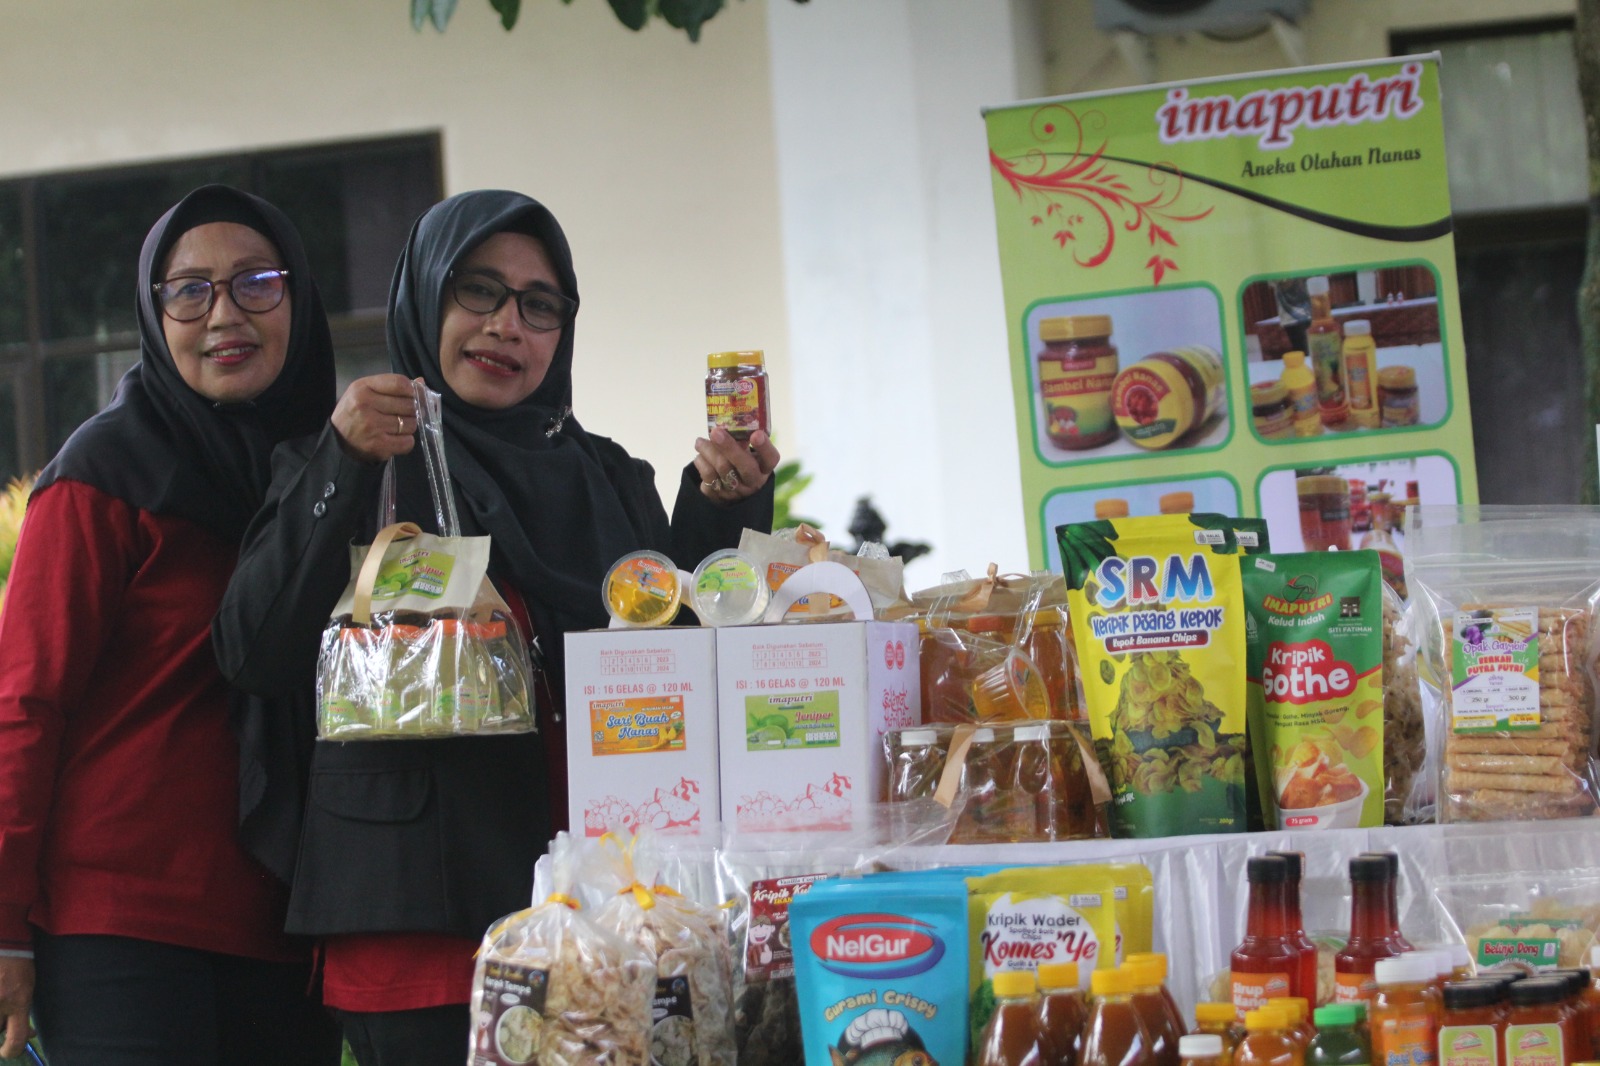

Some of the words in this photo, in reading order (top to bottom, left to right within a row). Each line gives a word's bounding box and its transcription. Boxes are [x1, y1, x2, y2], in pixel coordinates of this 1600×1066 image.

[1159, 62, 1421, 146] imaputri
[1241, 160, 1296, 178] Aneka
[1300, 151, 1362, 170] Olahan
[1368, 147, 1421, 164] Nanas
[1043, 378, 1083, 393] Sambel
[1086, 376, 1113, 389] Nana
[1097, 555, 1212, 606] SRM
[1263, 595, 1332, 614] IMAPUTRI
[1092, 614, 1130, 637] Keripik
[1180, 608, 1223, 629] Kepok
[1267, 615, 1295, 627] Kelud
[1297, 613, 1325, 627] Indah
[1136, 634, 1170, 646] Banana
[1172, 632, 1198, 644] Chips
[1463, 640, 1488, 656] Opak
[1491, 640, 1527, 651] Gambir
[1271, 646, 1326, 667] Kripik
[1478, 655, 1511, 665] BERKAH
[1467, 664, 1495, 676] PUTRA
[1497, 663, 1523, 673] PUTRI
[584, 685, 596, 695] ISI
[603, 684, 614, 694] 16
[616, 683, 644, 694] GELAS
[646, 683, 657, 694] @
[662, 682, 678, 692] 120
[680, 682, 693, 692] ML
[736, 680, 747, 690] ISI
[756, 680, 766, 689] 16
[768, 678, 796, 688] GELAS
[798, 678, 809, 689] @
[814, 677, 830, 687] 120
[832, 676, 845, 686] ML
[1262, 666, 1350, 698] Gothe
[593, 700, 625, 710] imaputri
[768, 694, 813, 705] imaputri
[607, 714, 633, 729] Sari
[634, 712, 670, 727] Buah
[795, 711, 834, 723] Jeniper
[618, 725, 659, 739] Nanas
[1298, 817, 1313, 825] gram
[753, 888, 789, 904] Kripik
[988, 913, 1027, 928] Kripik
[1032, 914, 1081, 927] Wader
[826, 934, 911, 958] NelGur
[1484, 942, 1515, 956] Belinjo
[1517, 942, 1539, 956] Dong
[505, 980, 532, 994] Tempe
[1233, 982, 1264, 997] Sirup
[653, 996, 677, 1007] empe
[825, 989, 877, 1022] Gurami
[883, 990, 937, 1019] Crispy
